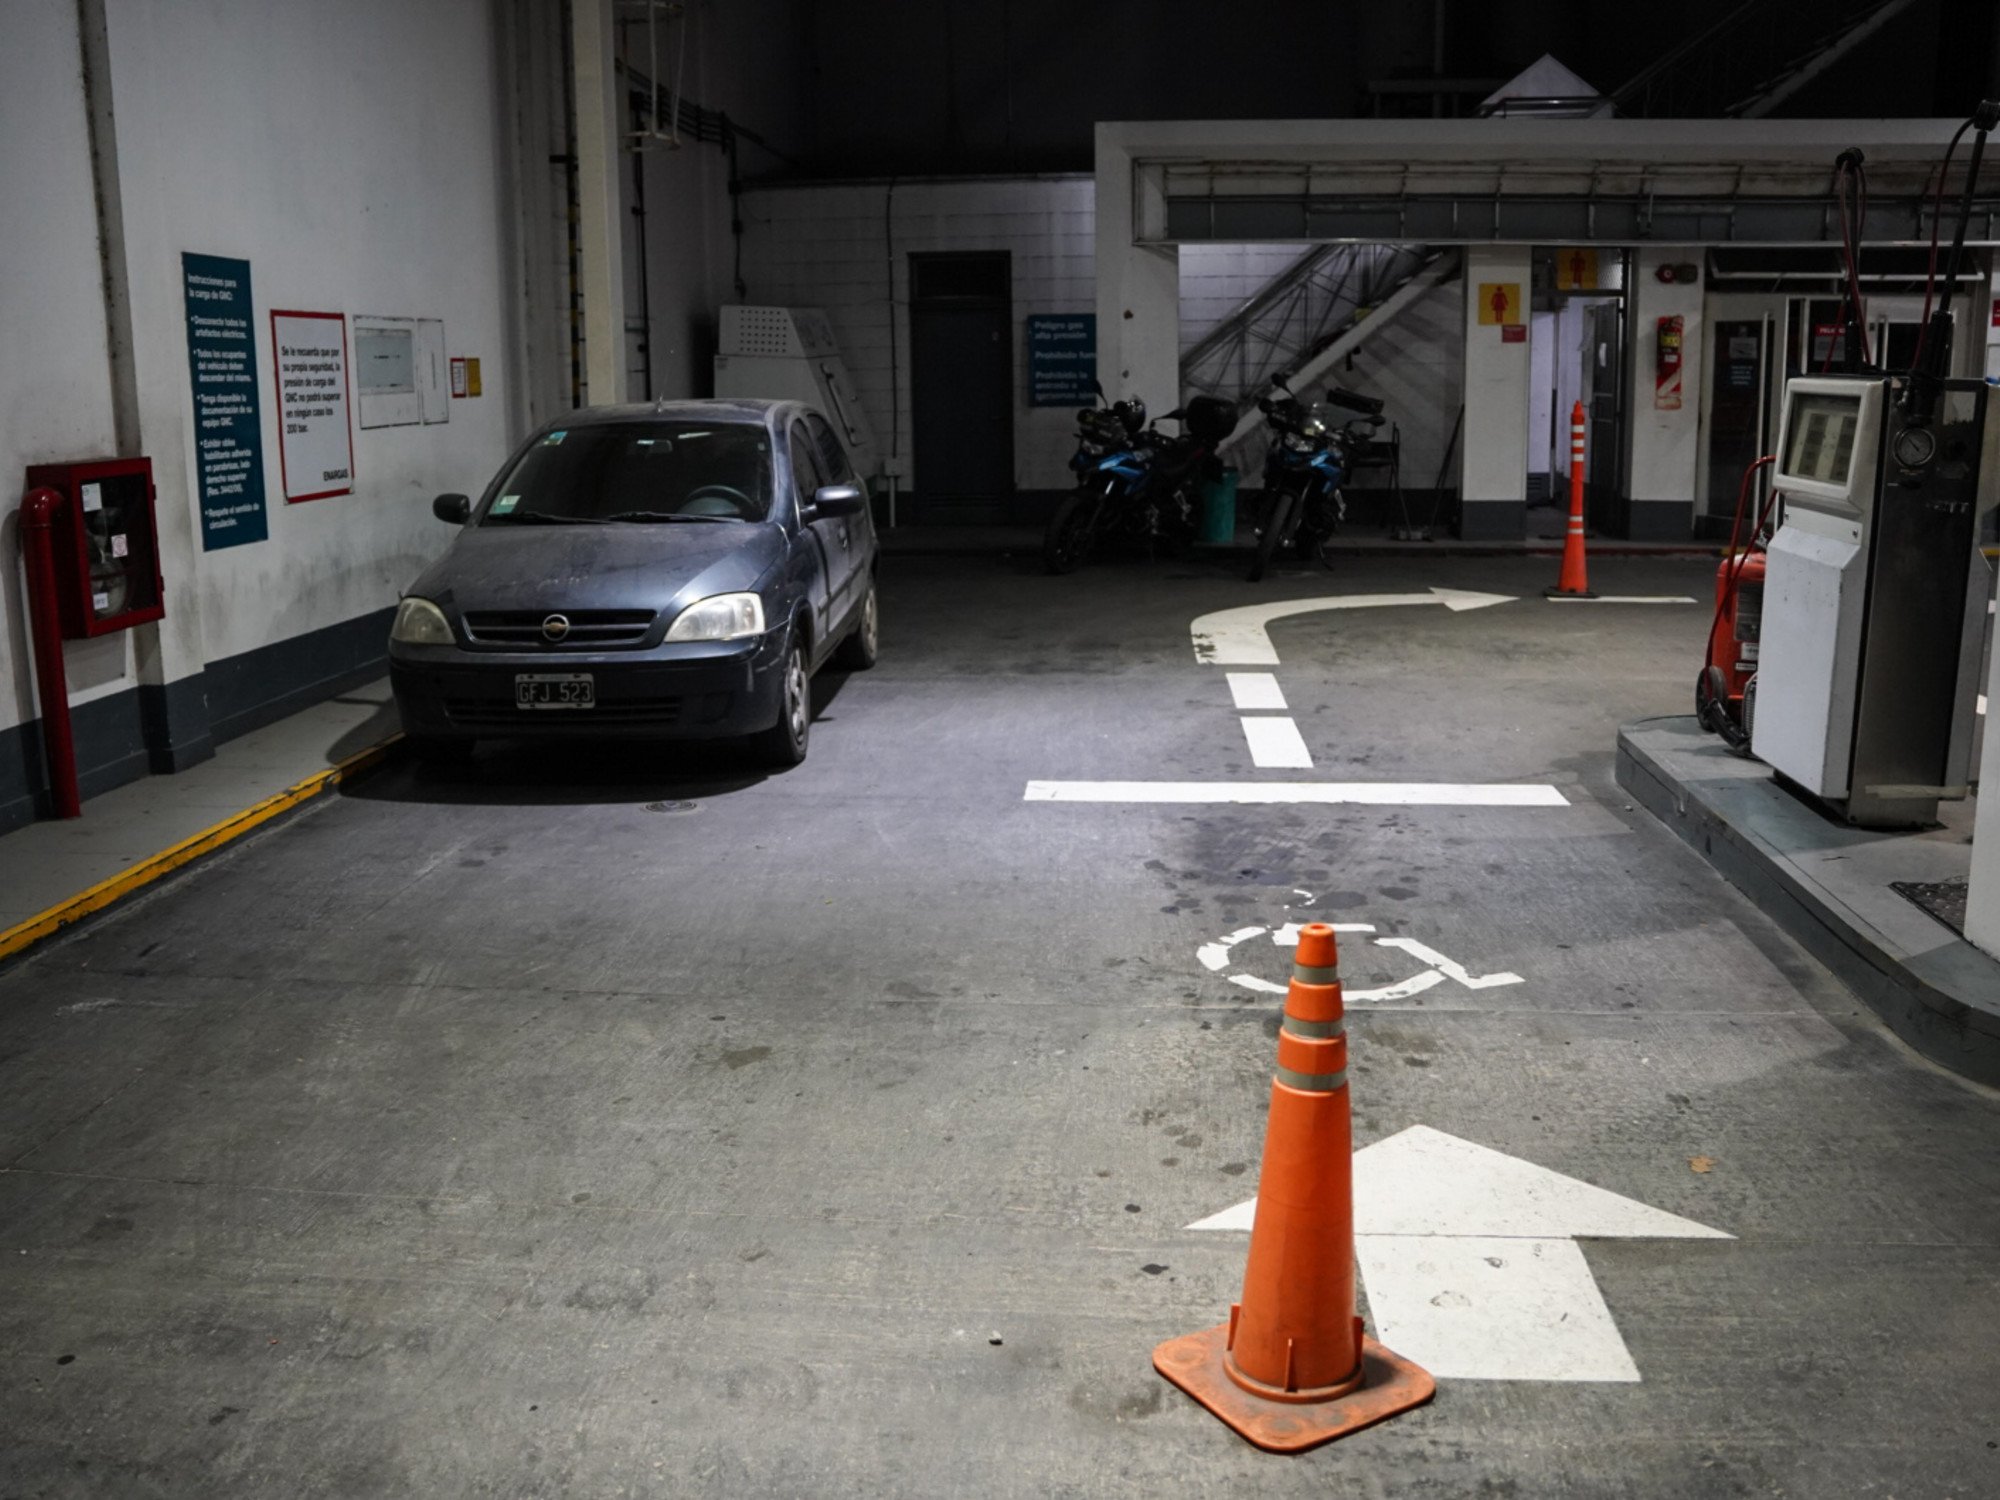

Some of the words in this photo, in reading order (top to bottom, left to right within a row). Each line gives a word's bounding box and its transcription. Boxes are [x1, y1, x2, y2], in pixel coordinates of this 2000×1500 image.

[188, 273, 224, 286] Instrucciones
[224, 279, 237, 288] para
[194, 290, 210, 300] carga
[211, 290, 218, 299] de
[1034, 321, 1066, 332] Peligro
[1067, 322, 1084, 331] gas
[281, 346, 289, 356] Se
[290, 347, 296, 356] le
[296, 348, 320, 357] recuerda
[321, 349, 330, 358] que
[331, 349, 340, 358] por
[1034, 350, 1078, 359] Prohibido
[291, 362, 308, 373] propia
[336, 362, 340, 372] la
[200, 373, 225, 382] descender
[1034, 371, 1078, 380] Prohibido
[284, 378, 304, 389] presión
[306, 378, 312, 386] de
[313, 379, 326, 388] carga
[328, 378, 336, 386] del
[286, 392, 298, 402] GNC
[306, 392, 320, 403] podrá
[322, 393, 341, 402] superar
[286, 410, 293, 418] en
[294, 408, 311, 420] ningún
[312, 408, 324, 416] caso
[326, 407, 334, 416] los
[287, 423, 296, 434] 200
[323, 468, 348, 482] ENARGAS
[520, 682, 550, 702] GFJ
[560, 682, 590, 701] 523
